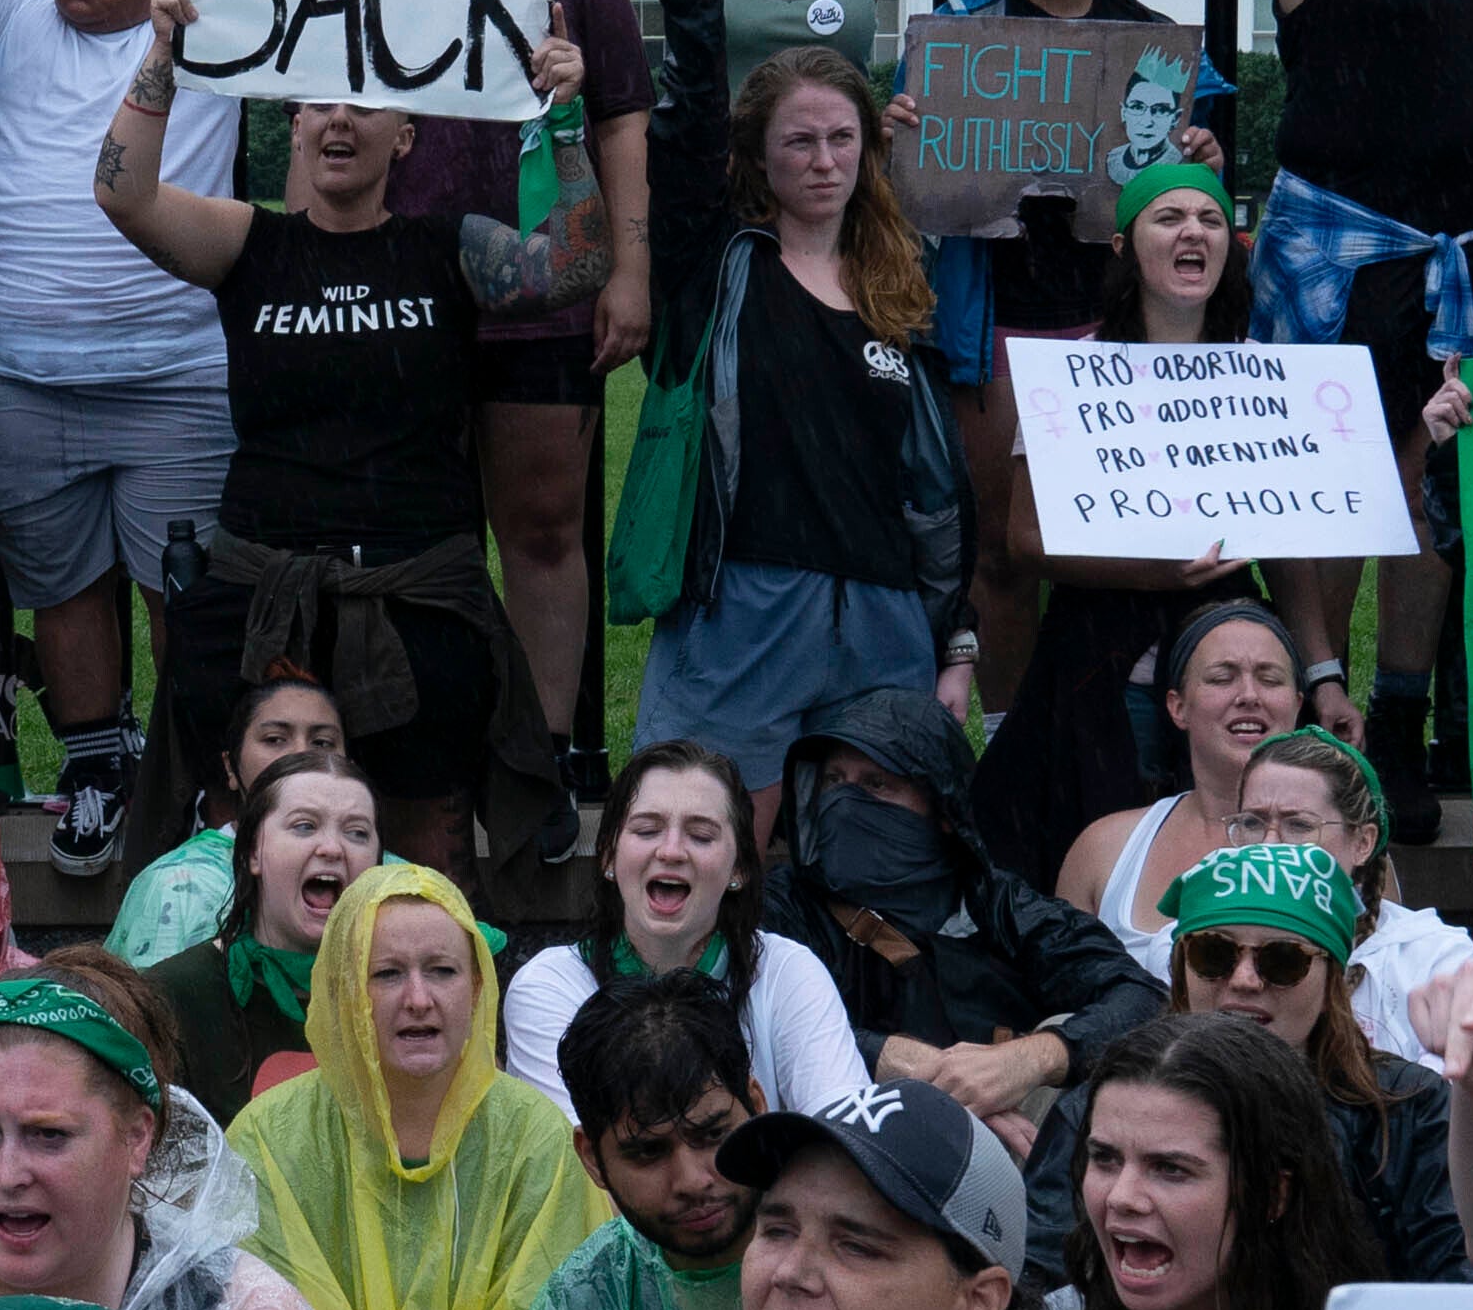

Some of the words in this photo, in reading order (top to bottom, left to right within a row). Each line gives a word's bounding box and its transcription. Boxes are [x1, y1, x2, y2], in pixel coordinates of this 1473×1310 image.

[923, 42, 1092, 104] FIGHT
[918, 115, 1105, 174] RUTHLESSLY
[322, 285, 370, 301] WILD
[254, 297, 435, 334] FEMINIST
[1067, 353, 1133, 387] PRO
[1079, 401, 1134, 434] PRO
[1097, 446, 1145, 473] PRO
[1074, 489, 1171, 523] PRO
[1196, 489, 1364, 518] CHOICE
[1213, 860, 1333, 915] BANS
